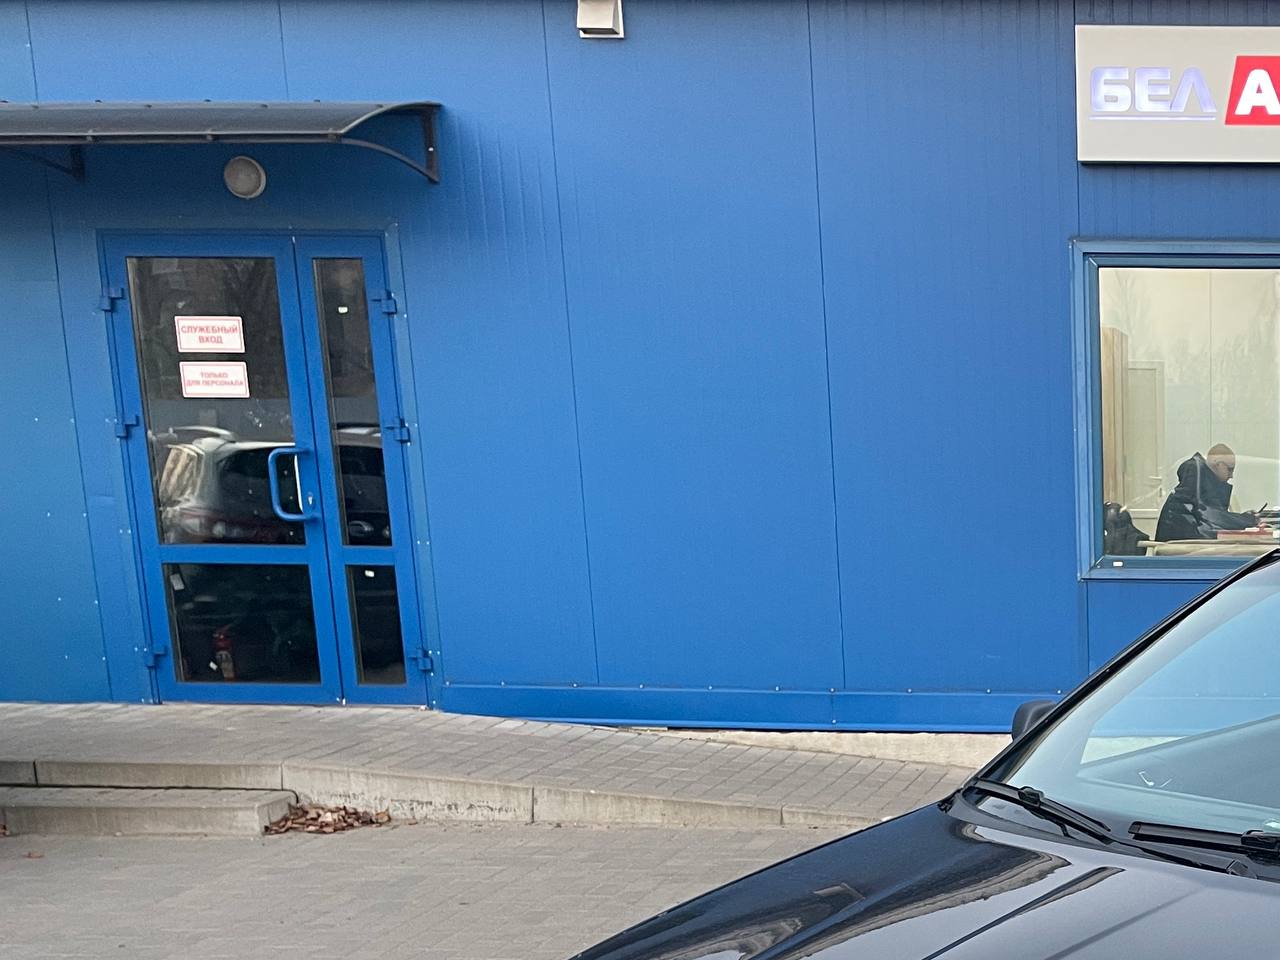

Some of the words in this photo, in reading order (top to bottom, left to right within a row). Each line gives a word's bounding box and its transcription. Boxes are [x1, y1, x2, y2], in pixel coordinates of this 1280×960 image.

[1089, 66, 1217, 114] БЕЛ
[181, 325, 238, 334] СЛУЖЕБНЫЙ
[199, 335, 223, 344] ВХОД
